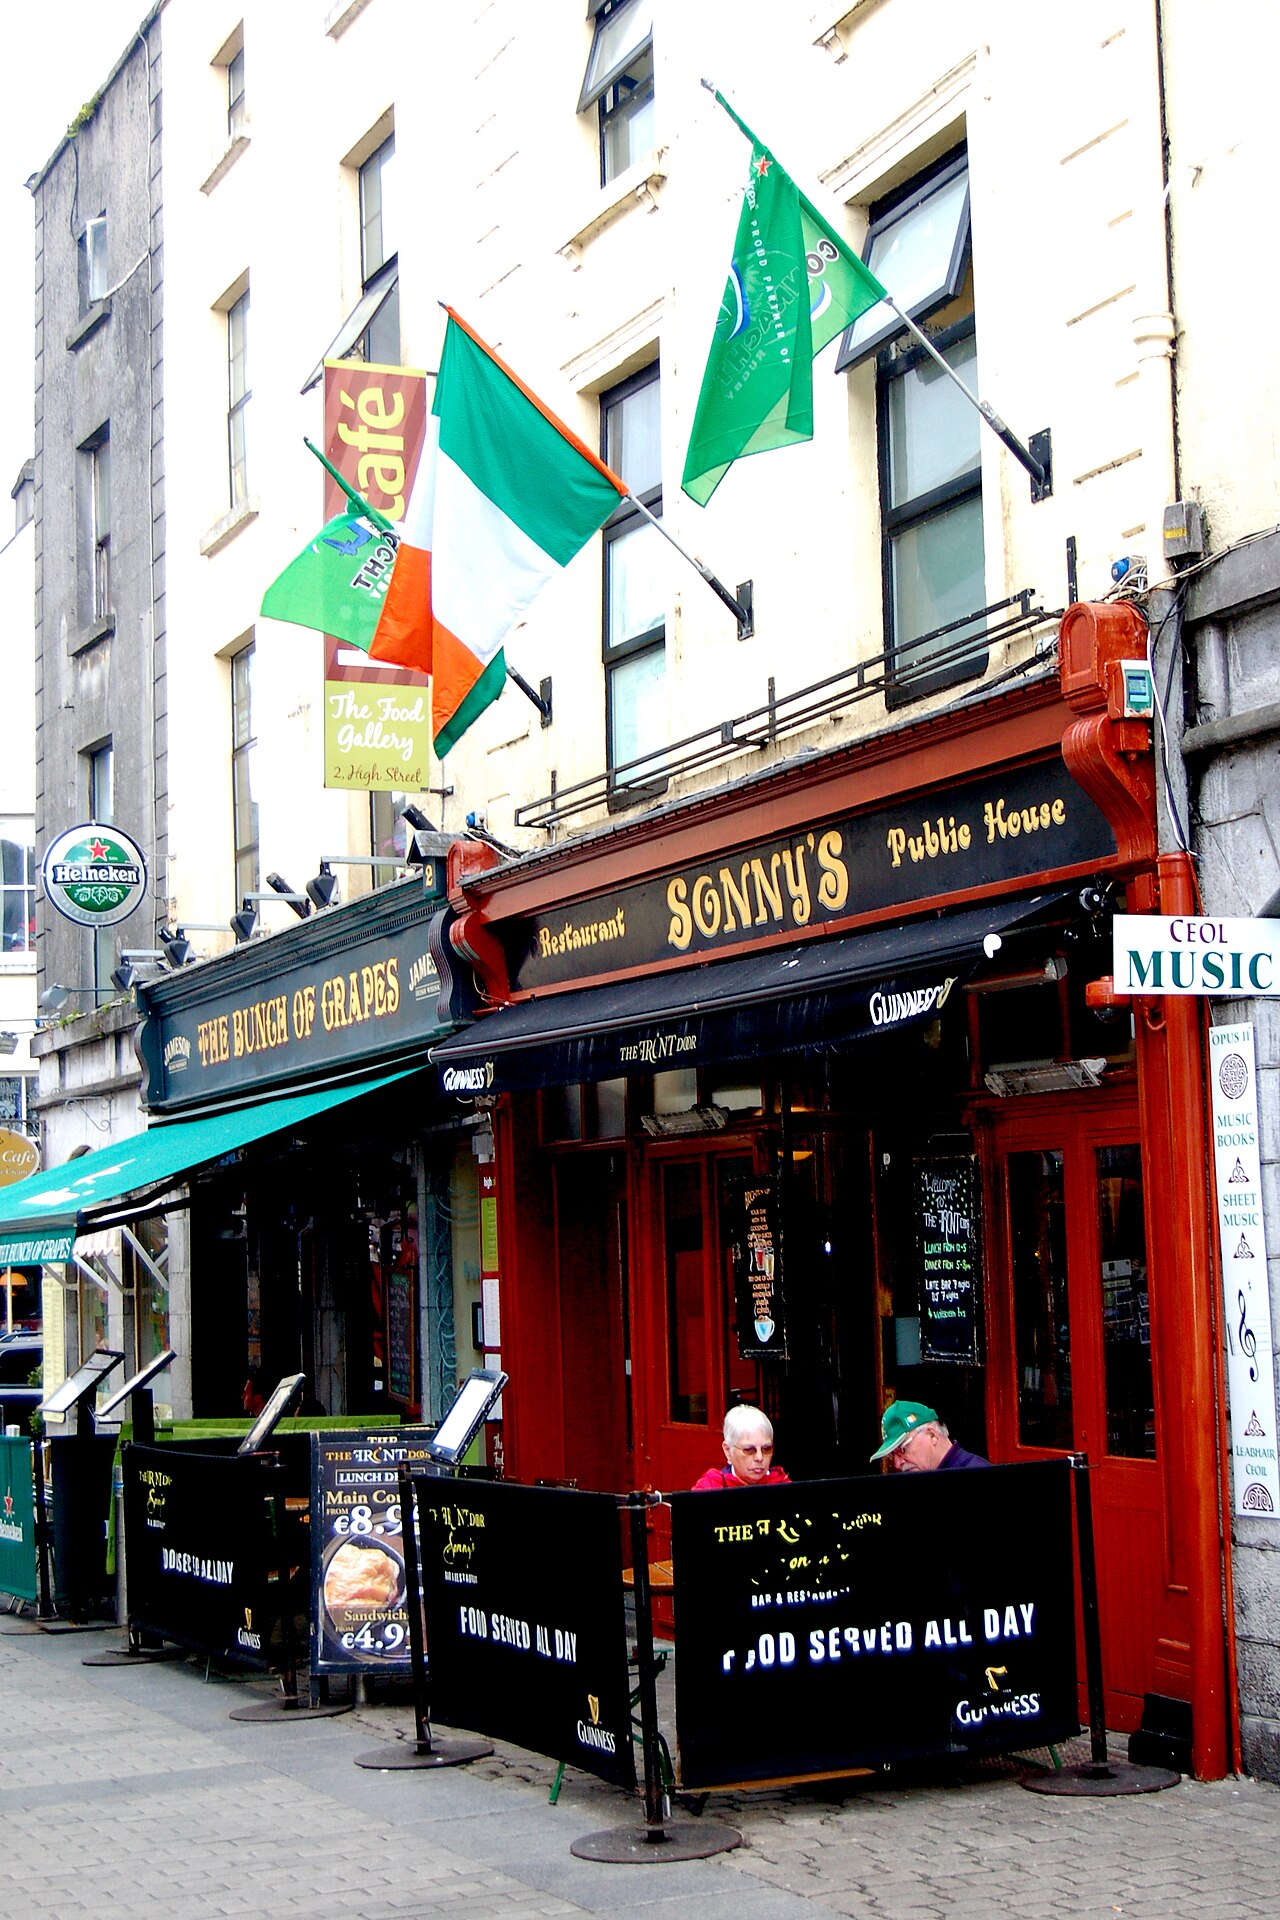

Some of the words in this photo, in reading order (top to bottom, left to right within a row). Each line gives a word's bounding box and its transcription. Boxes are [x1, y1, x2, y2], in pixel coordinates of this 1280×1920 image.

[750, 219, 768, 267] PROUD
[762, 275, 786, 340] PARTNER
[779, 346, 791, 364] OF
[338, 386, 405, 521] café
[329, 690, 372, 719] The
[376, 697, 425, 723] Food
[337, 721, 413, 762] Gallery
[347, 763, 383, 786] High
[384, 766, 423, 784] Street
[55, 865, 138, 883] Heineken
[424, 863, 434, 888] 2
[538, 906, 627, 959] Restaurant
[666, 830, 850, 950] SONNY'S
[886, 816, 972, 868] Public
[983, 798, 1067, 844] House
[1169, 919, 1228, 944] CEOL
[408, 952, 437, 992] JAMES
[1126, 950, 1274, 990] MUSIC
[197, 1014, 231, 1067] THE
[232, 994, 289, 1058] BUNCH
[292, 984, 317, 1040] OF
[321, 956, 401, 1032] GRAPES
[1211, 1031, 1240, 1046] OPUS
[619, 1045, 639, 1062] THE
[443, 1066, 486, 1092] GUINNESS
[1217, 1112, 1254, 1128] MUSIC
[1217, 1132, 1255, 1148] BOOKS
[2, 1149, 34, 1166] Cafe
[1222, 1193, 1257, 1208] SHEET
[1223, 1212, 1259, 1227] MUSIC
[41, 1237, 71, 1260] GRAPES
[325, 1451, 352, 1461] THE
[339, 1471, 382, 1483] LUNCH
[326, 1490, 369, 1505] Main
[326, 1507, 349, 1515] FROM
[333, 1504, 412, 1536] €8.9
[714, 1524, 754, 1542] THE
[216, 1560, 234, 1585] DAY
[751, 1593, 772, 1607] BAR
[344, 1608, 408, 1622] Sandwich
[924, 1618, 972, 1648] ALL
[983, 1602, 1035, 1640] DAY
[459, 1605, 488, 1639] FOOD
[491, 1612, 531, 1650] SERVED
[536, 1624, 552, 1657] ALL
[554, 1628, 577, 1663] DAY
[576, 1719, 616, 1754] GUINNESS
